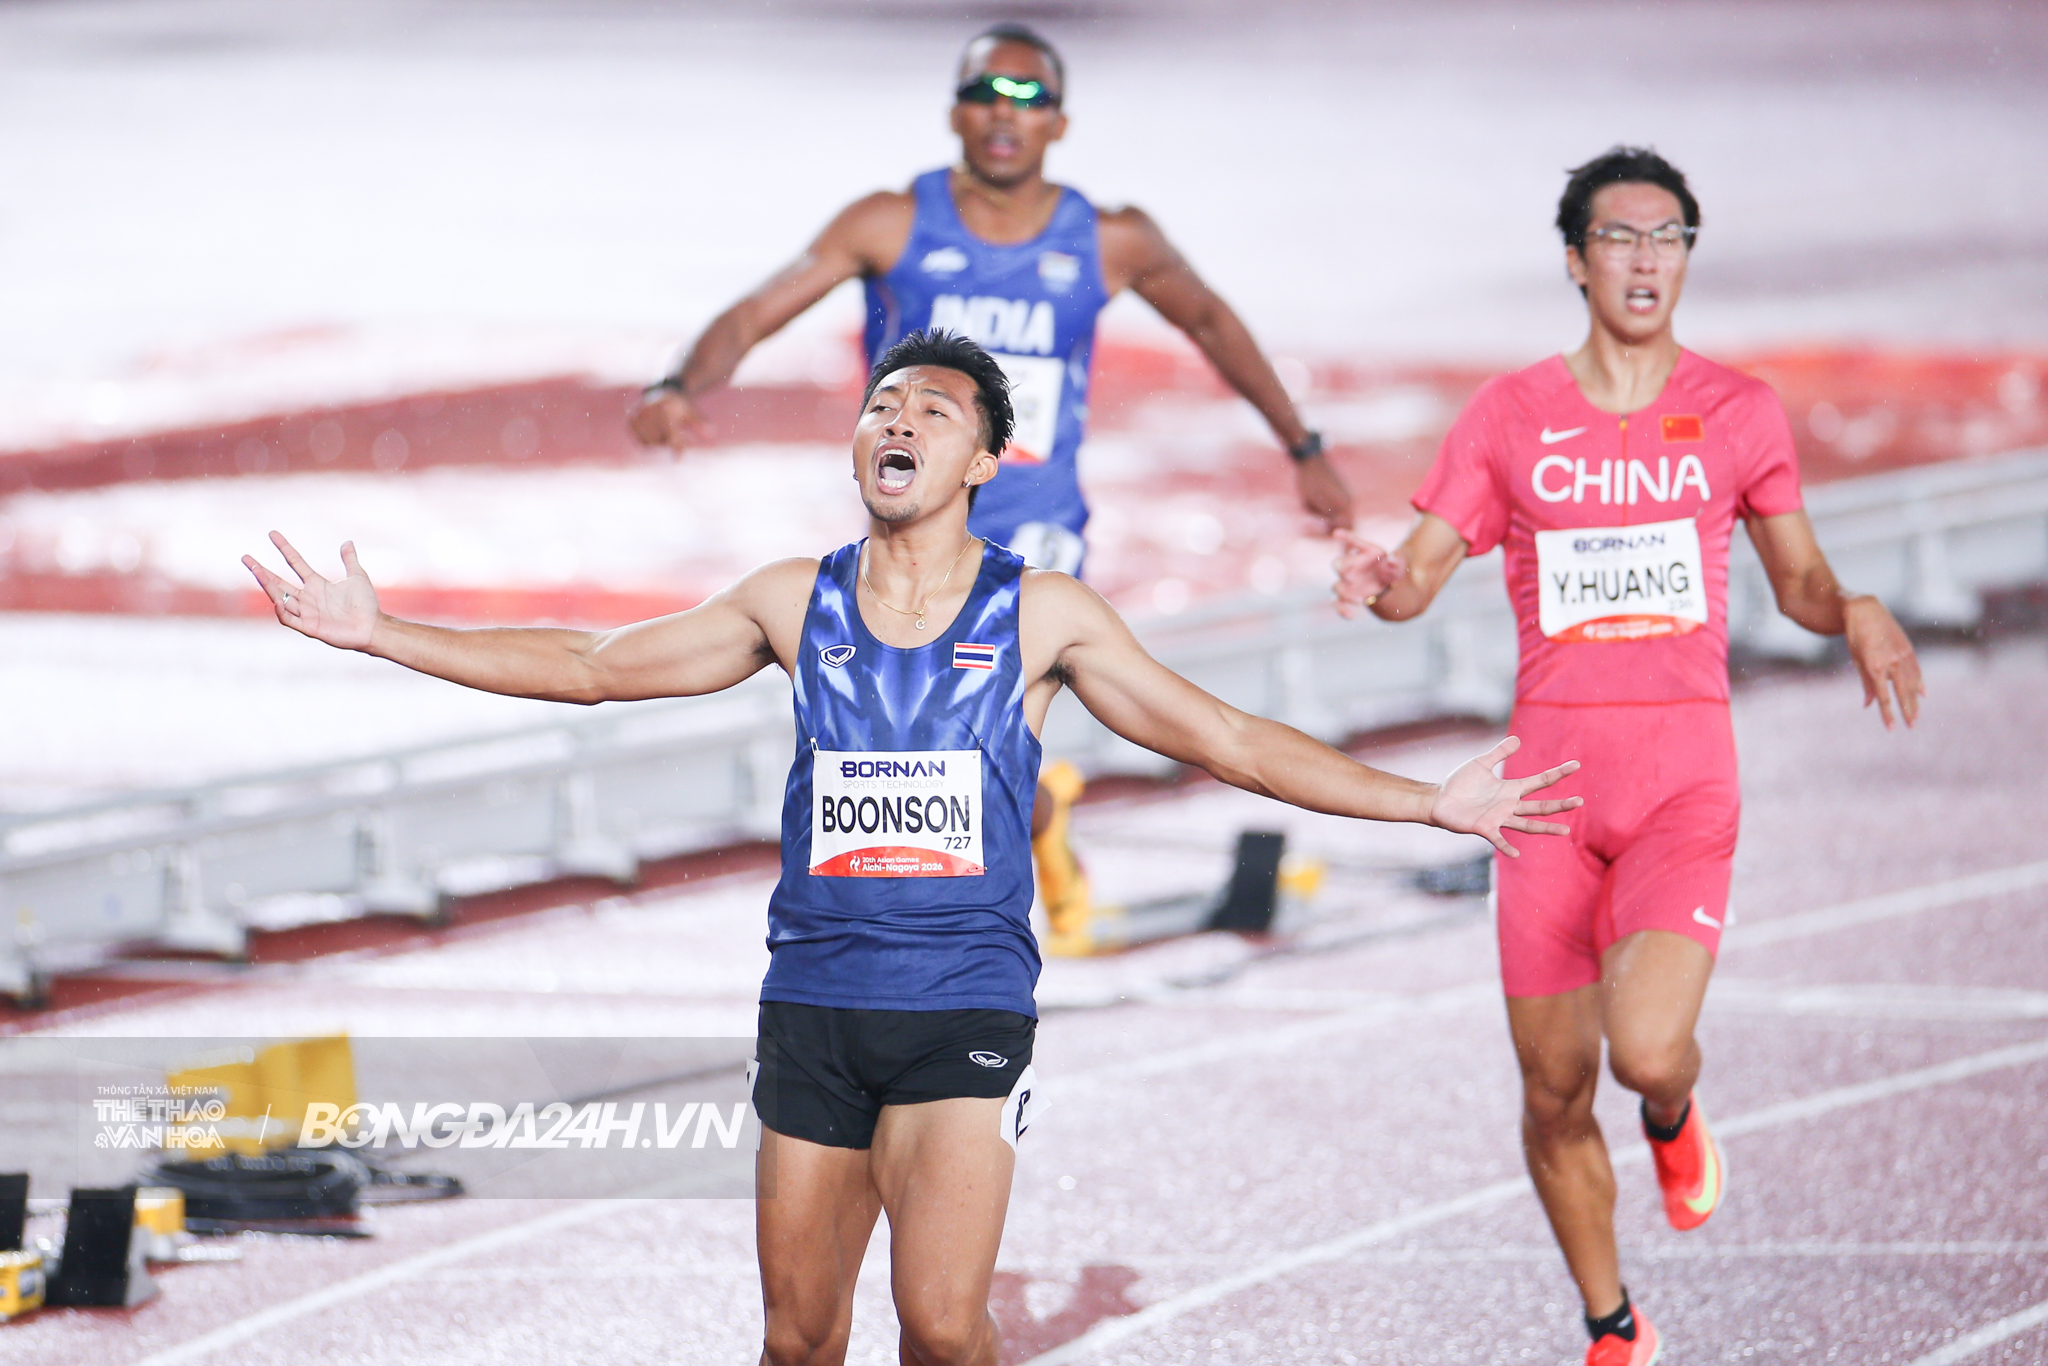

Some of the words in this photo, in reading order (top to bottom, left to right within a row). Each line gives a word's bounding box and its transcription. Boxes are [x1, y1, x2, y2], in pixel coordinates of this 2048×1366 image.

[928, 295, 1055, 354] INDIA
[1532, 454, 1711, 505] CHINA
[1573, 533, 1665, 553] BORNAN
[1553, 562, 1690, 604] Y.HUANG
[839, 760, 945, 778] BORNAN
[843, 780, 877, 789] SPORTS
[881, 780, 945, 789] TECHNOLOGY
[822, 795, 970, 833] BOONSON
[943, 836, 971, 850] 727
[862, 863, 919, 873] Aichi-Nagoya
[921, 863, 943, 871] 2026
